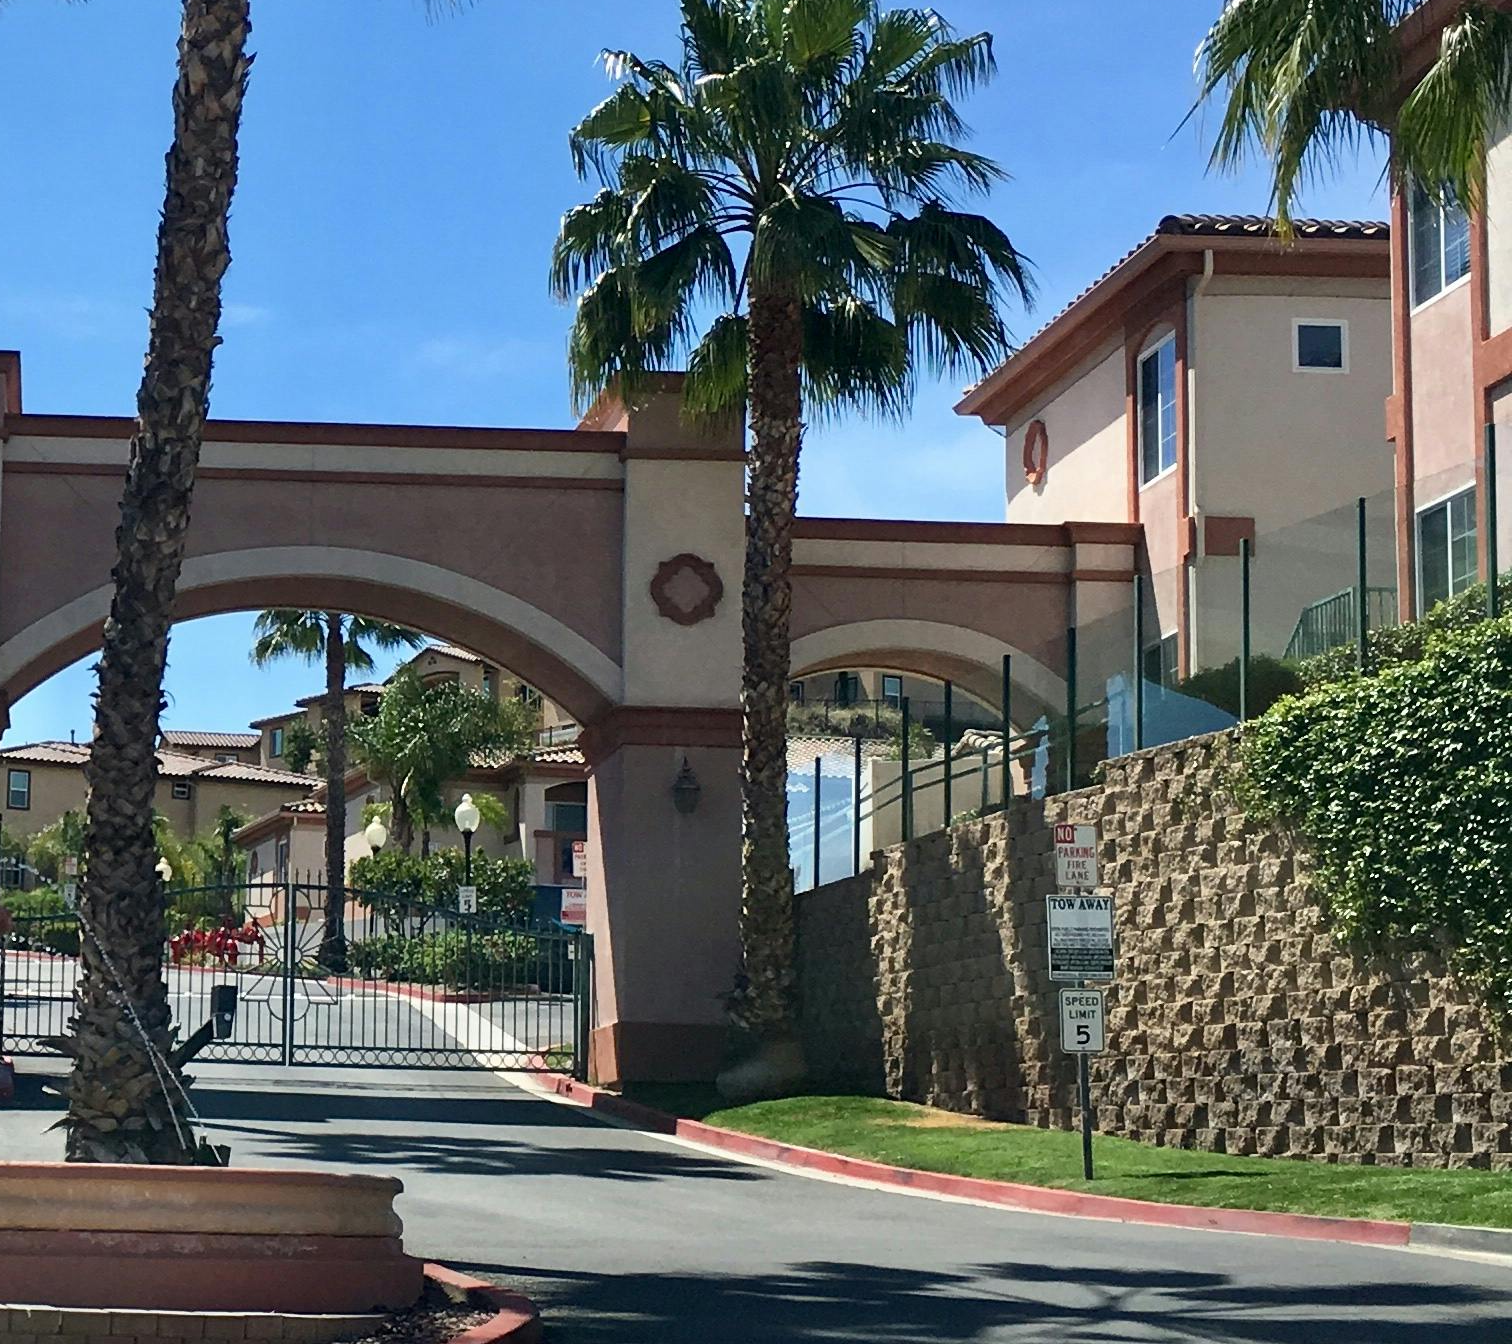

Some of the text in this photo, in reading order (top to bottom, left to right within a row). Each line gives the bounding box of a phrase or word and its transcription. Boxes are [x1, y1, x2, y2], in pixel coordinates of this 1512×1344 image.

[1057, 826, 1072, 841] NO
[1058, 846, 1095, 858] PARKING
[1067, 860, 1087, 870] FIRE
[1065, 871, 1089, 881] LANE
[1050, 898, 1109, 911] TOW AWAY
[1065, 996, 1099, 1007] SPEED
[1069, 1009, 1096, 1020] LIMIT
[1076, 1024, 1091, 1045] 5
